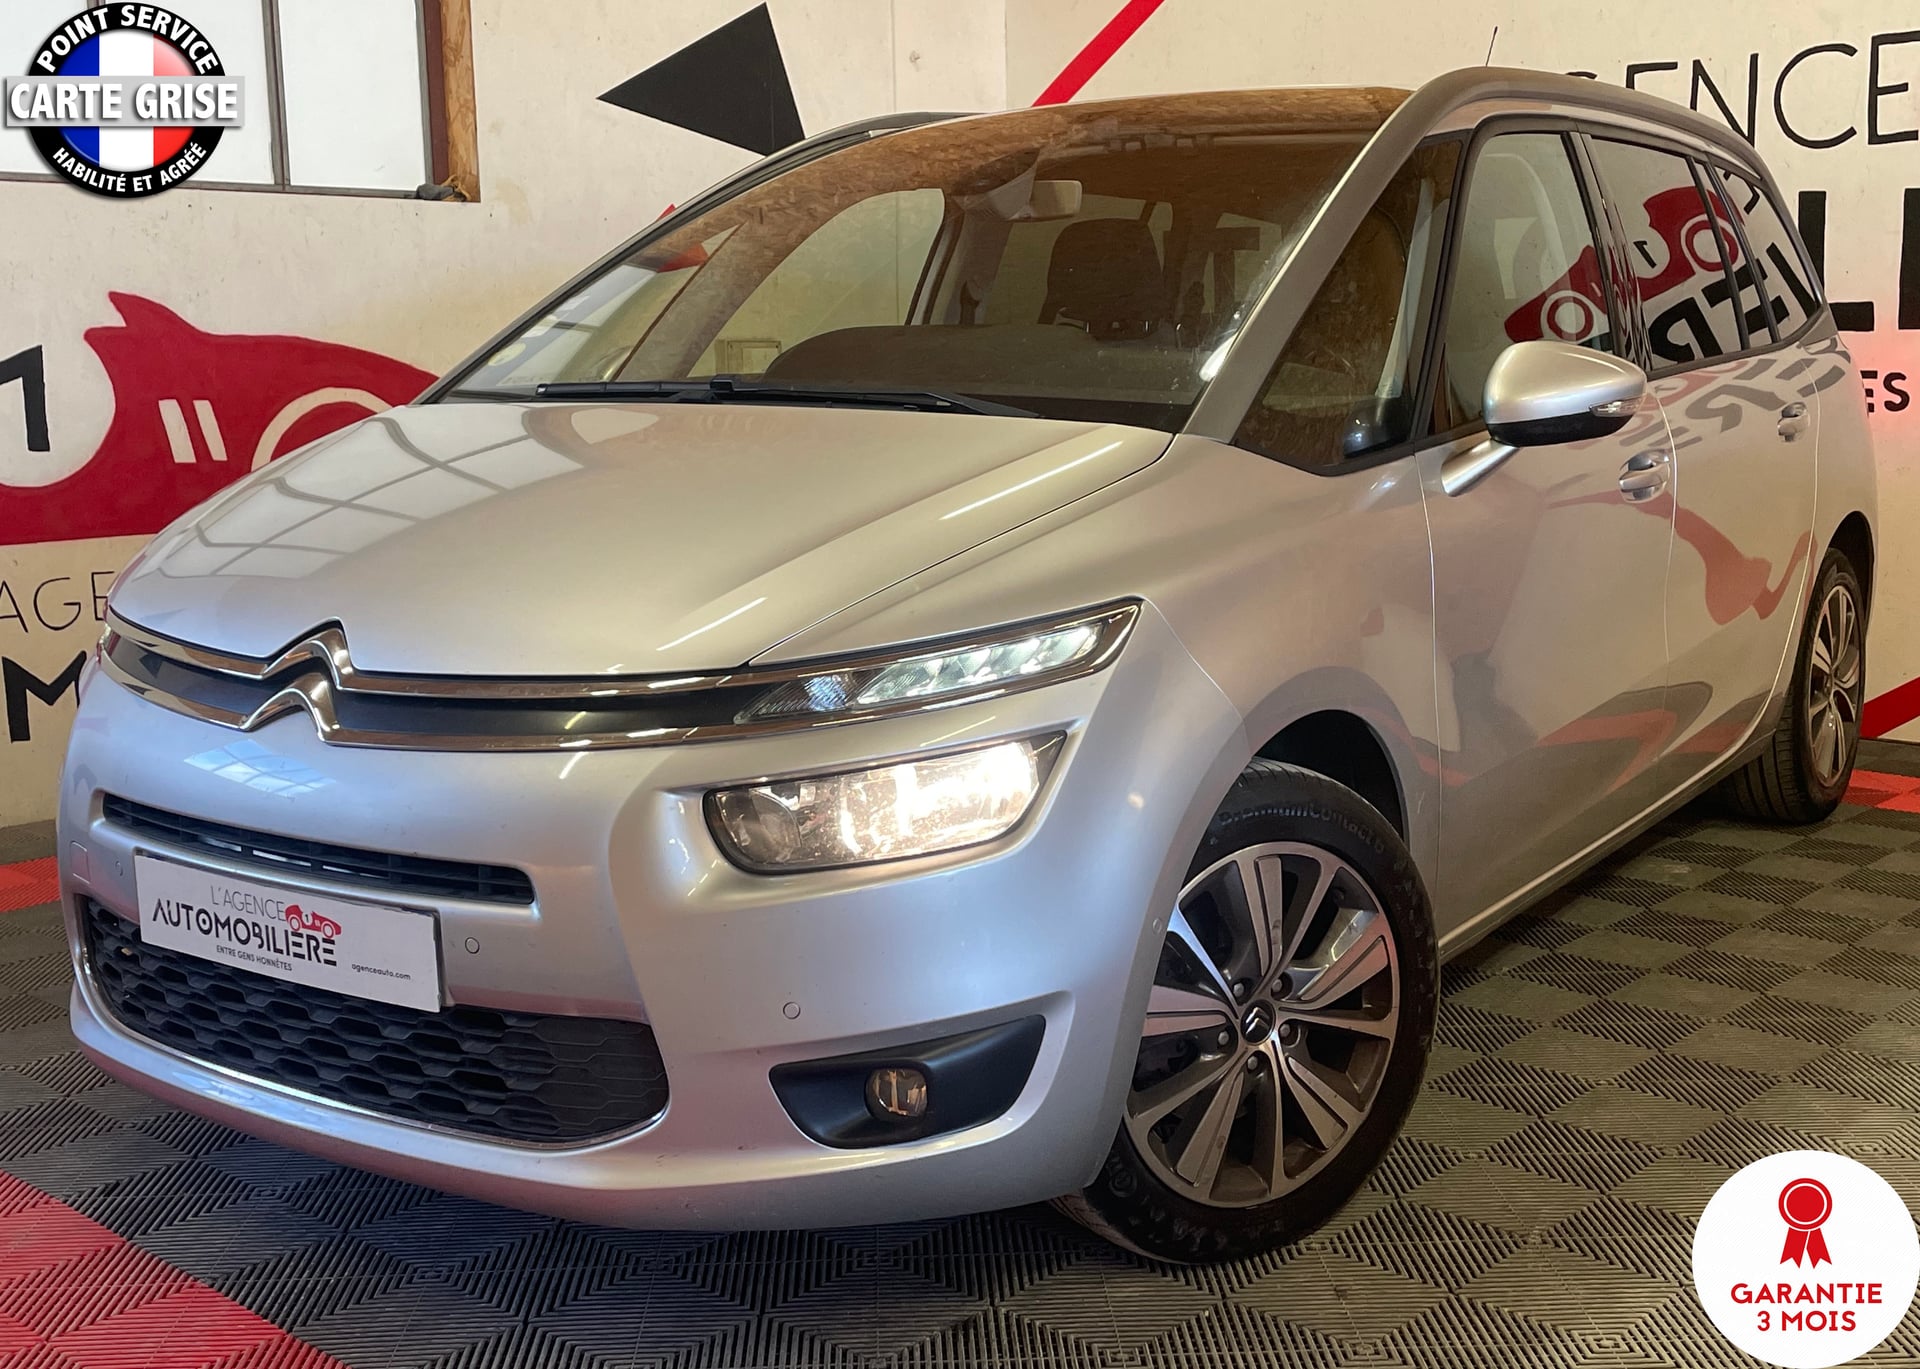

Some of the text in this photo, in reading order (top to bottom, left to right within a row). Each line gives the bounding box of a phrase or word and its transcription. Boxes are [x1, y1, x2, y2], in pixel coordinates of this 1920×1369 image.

[210, 885, 287, 922] L'AGENCE
[216, 944, 237, 958] ENTRE
[237, 950, 256, 963] GENS
[351, 963, 412, 981] agenceauto.com
